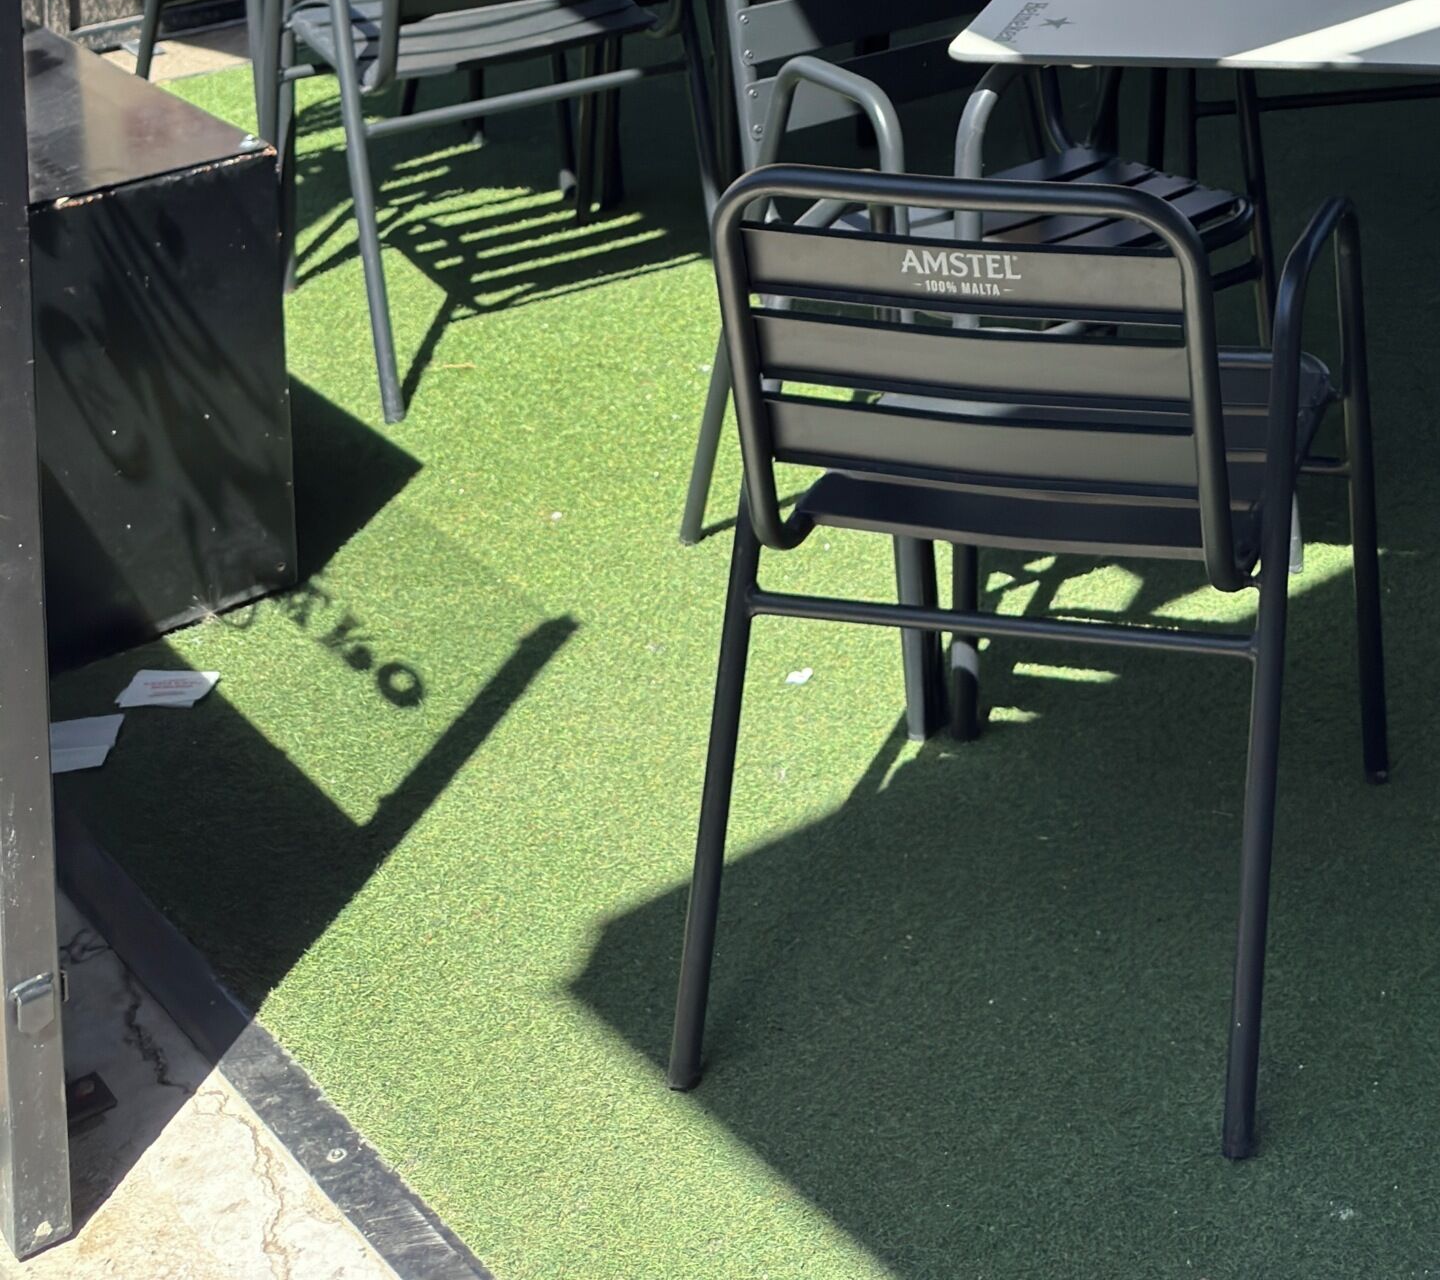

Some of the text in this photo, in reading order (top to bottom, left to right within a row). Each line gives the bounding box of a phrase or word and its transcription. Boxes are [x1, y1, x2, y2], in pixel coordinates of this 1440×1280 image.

[901, 248, 1022, 280] AMSTEL
[925, 279, 1001, 297] 100% MALTA
